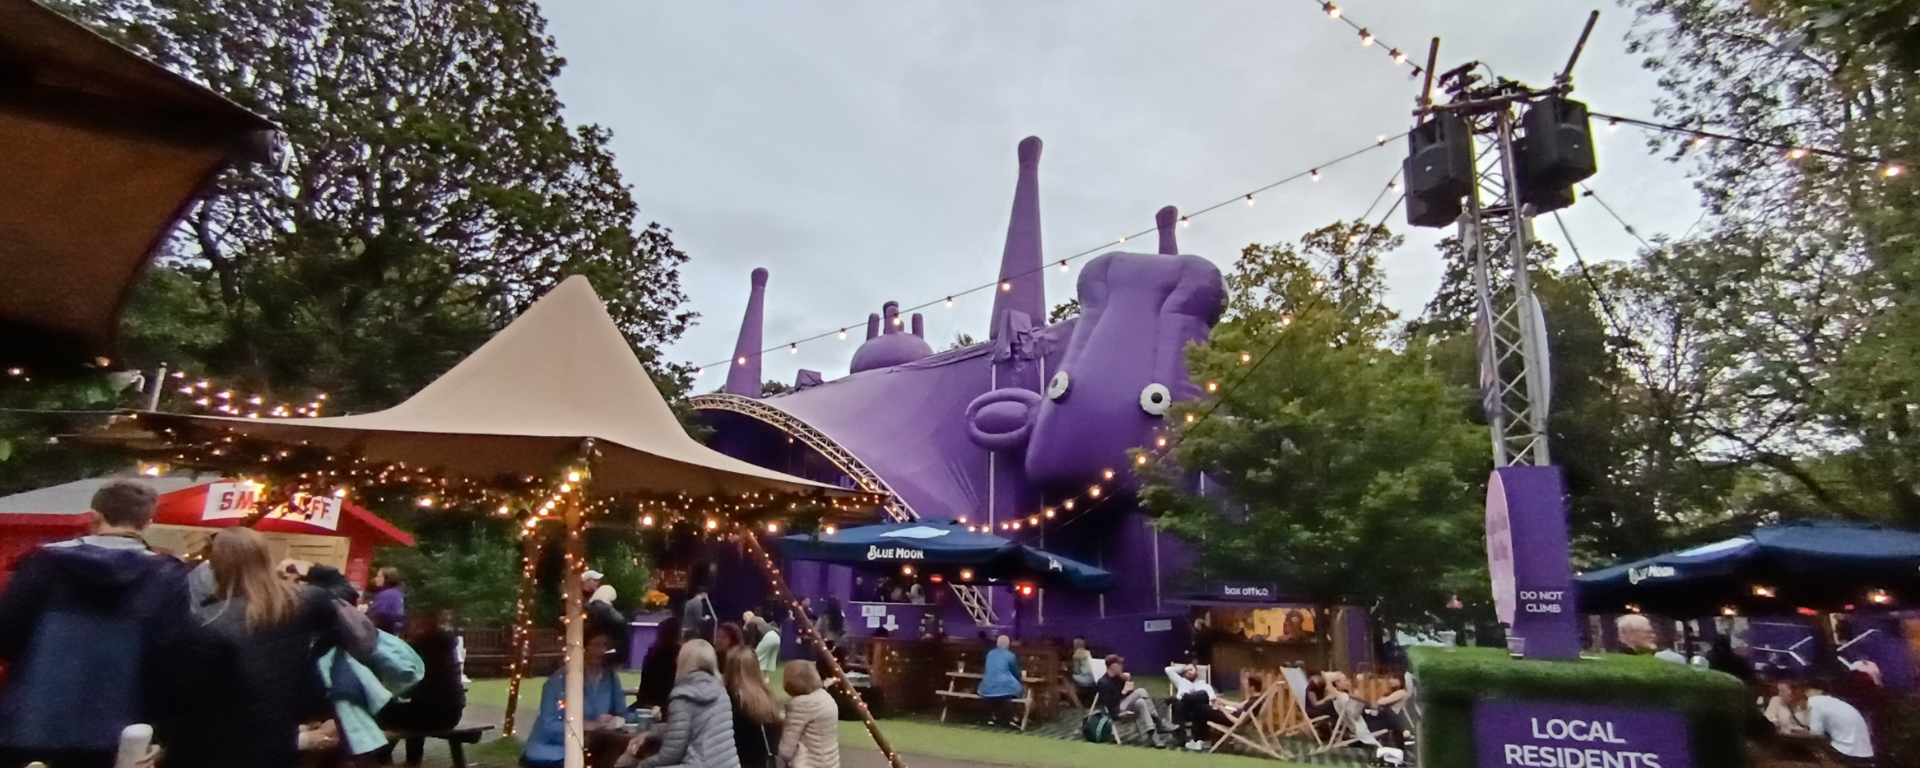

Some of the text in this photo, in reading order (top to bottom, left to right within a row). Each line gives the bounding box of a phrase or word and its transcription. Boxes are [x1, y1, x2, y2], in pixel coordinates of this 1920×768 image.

[867, 545, 924, 560] BLUE MOON
[1224, 585, 1269, 597] box office
[1520, 591, 1564, 600] DO NOT
[1525, 603, 1562, 613] CLIMB
[1531, 717, 1628, 744] LOCAL
[1504, 744, 1663, 768] RESIDENTS
